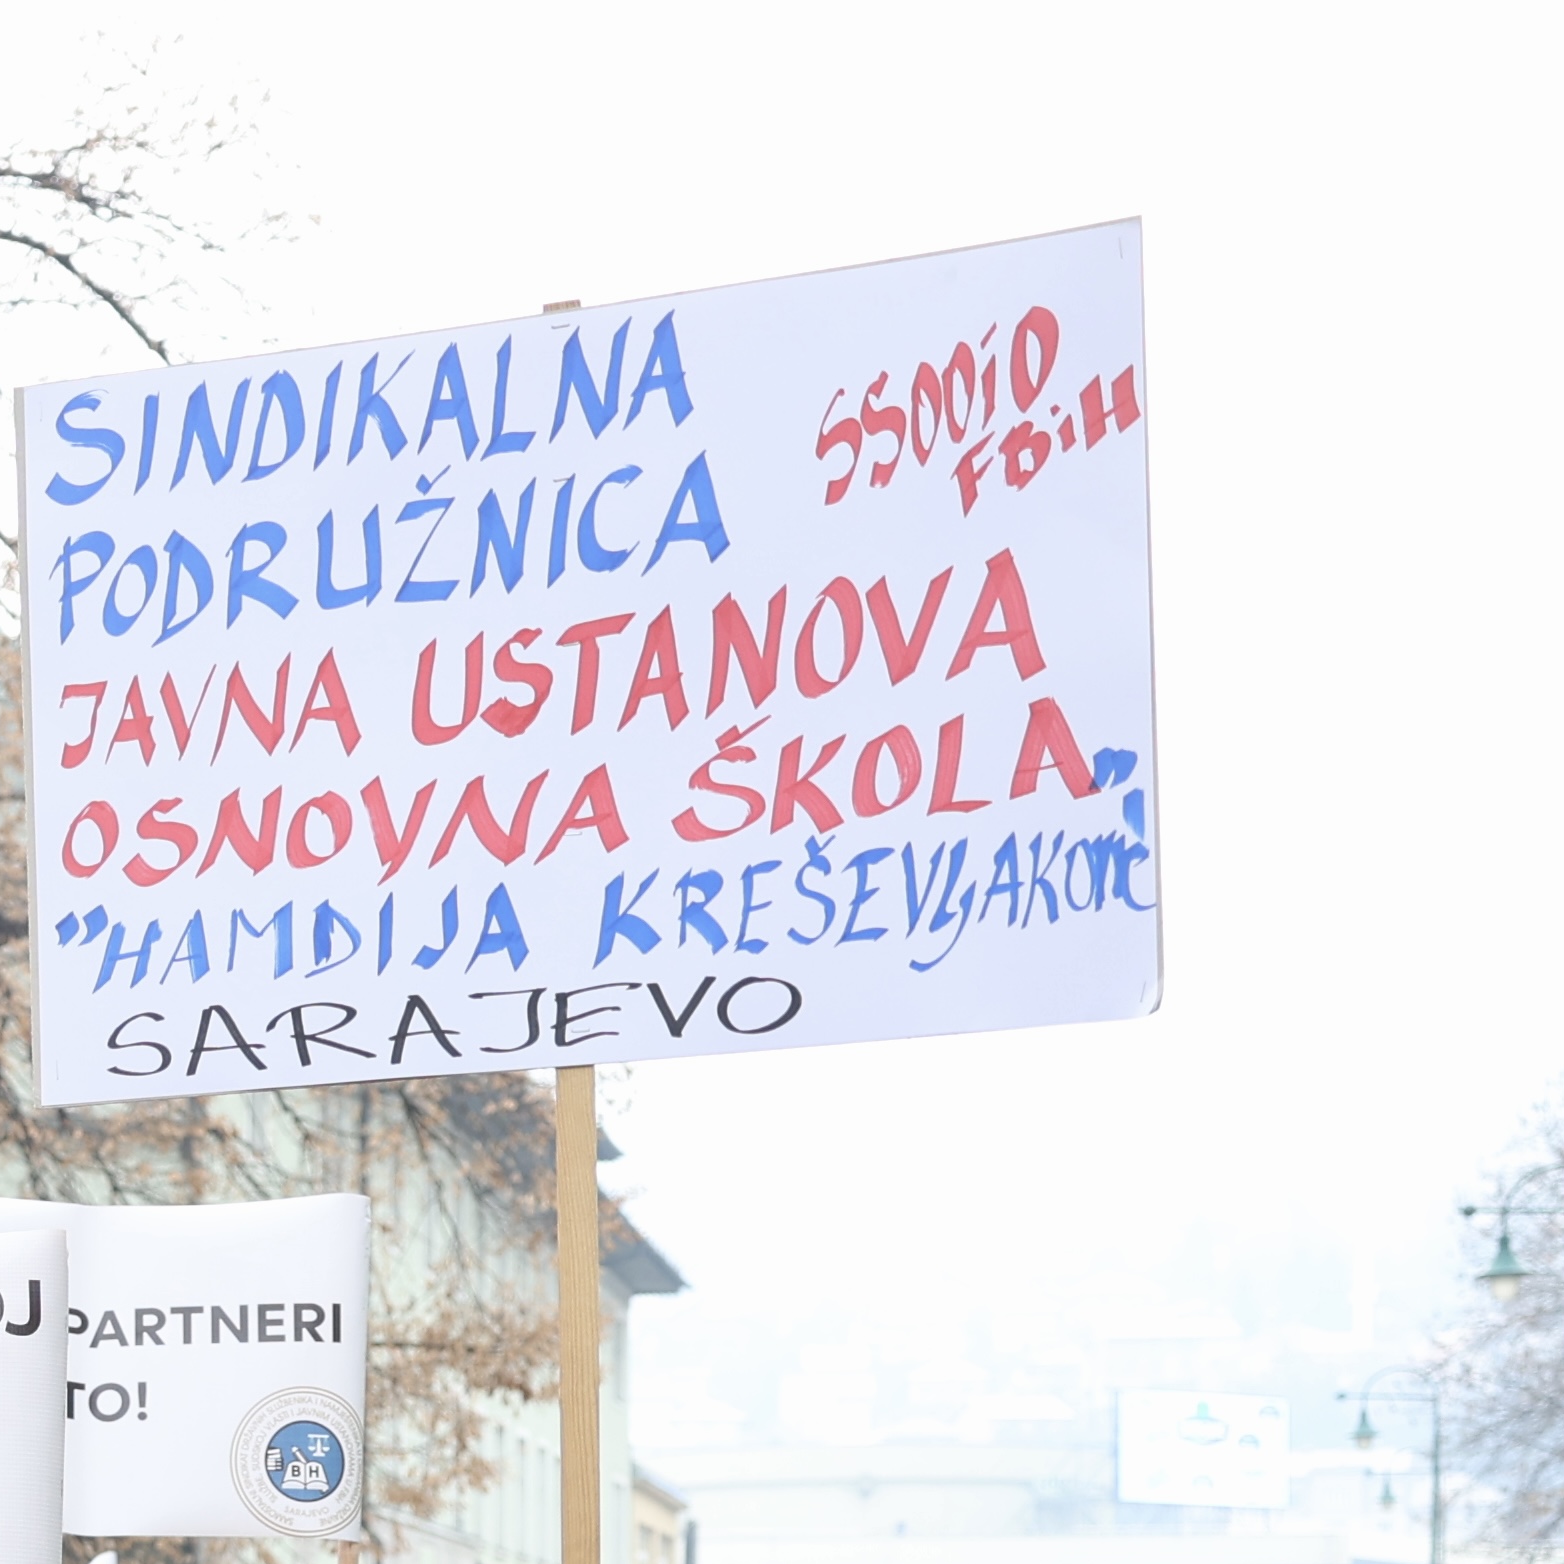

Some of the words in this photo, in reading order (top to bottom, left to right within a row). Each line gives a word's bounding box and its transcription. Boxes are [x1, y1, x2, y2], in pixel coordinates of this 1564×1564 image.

[45, 309, 694, 506] SINDIKALNA
[49, 450, 730, 648] PODRUŽNICA
[60, 647, 362, 769] JAVNA
[411, 547, 1047, 746] USTANOVA
[62, 763, 630, 887] OSNOVNA
[671, 697, 1101, 844] ŠKOLA
[107, 976, 802, 1076] SARAJEVO
